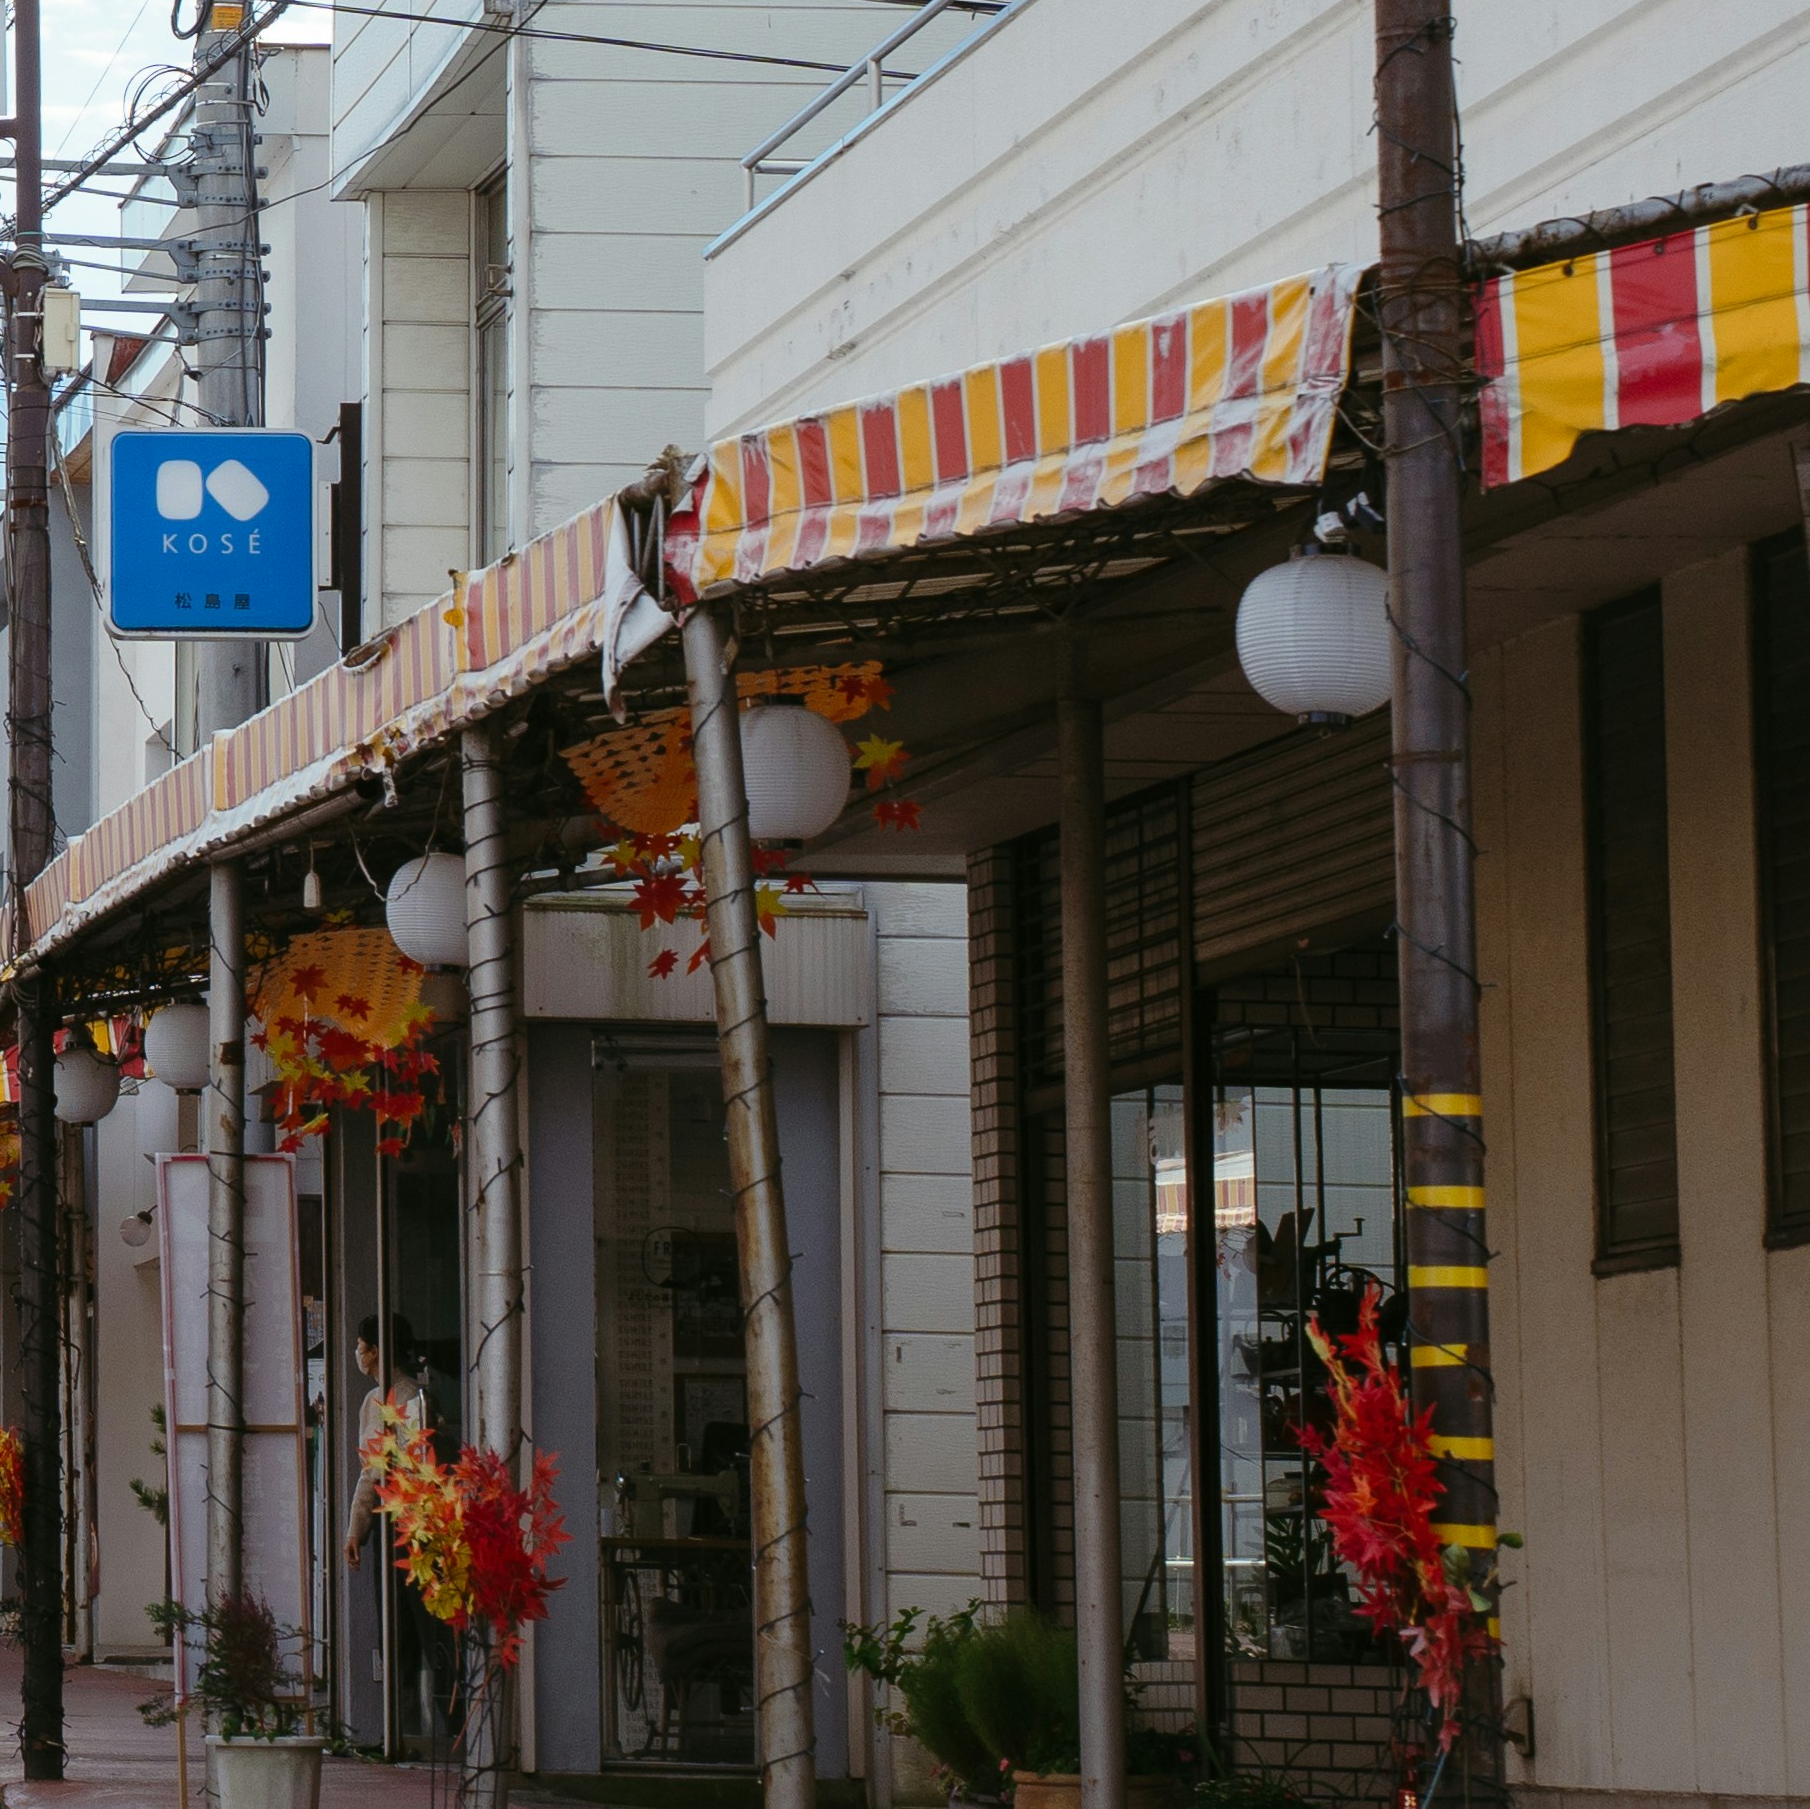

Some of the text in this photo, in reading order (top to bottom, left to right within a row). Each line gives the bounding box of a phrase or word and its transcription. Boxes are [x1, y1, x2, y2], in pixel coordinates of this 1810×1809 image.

[162, 528, 262, 555] KOSÉ
[174, 591, 252, 611] 松島屋
